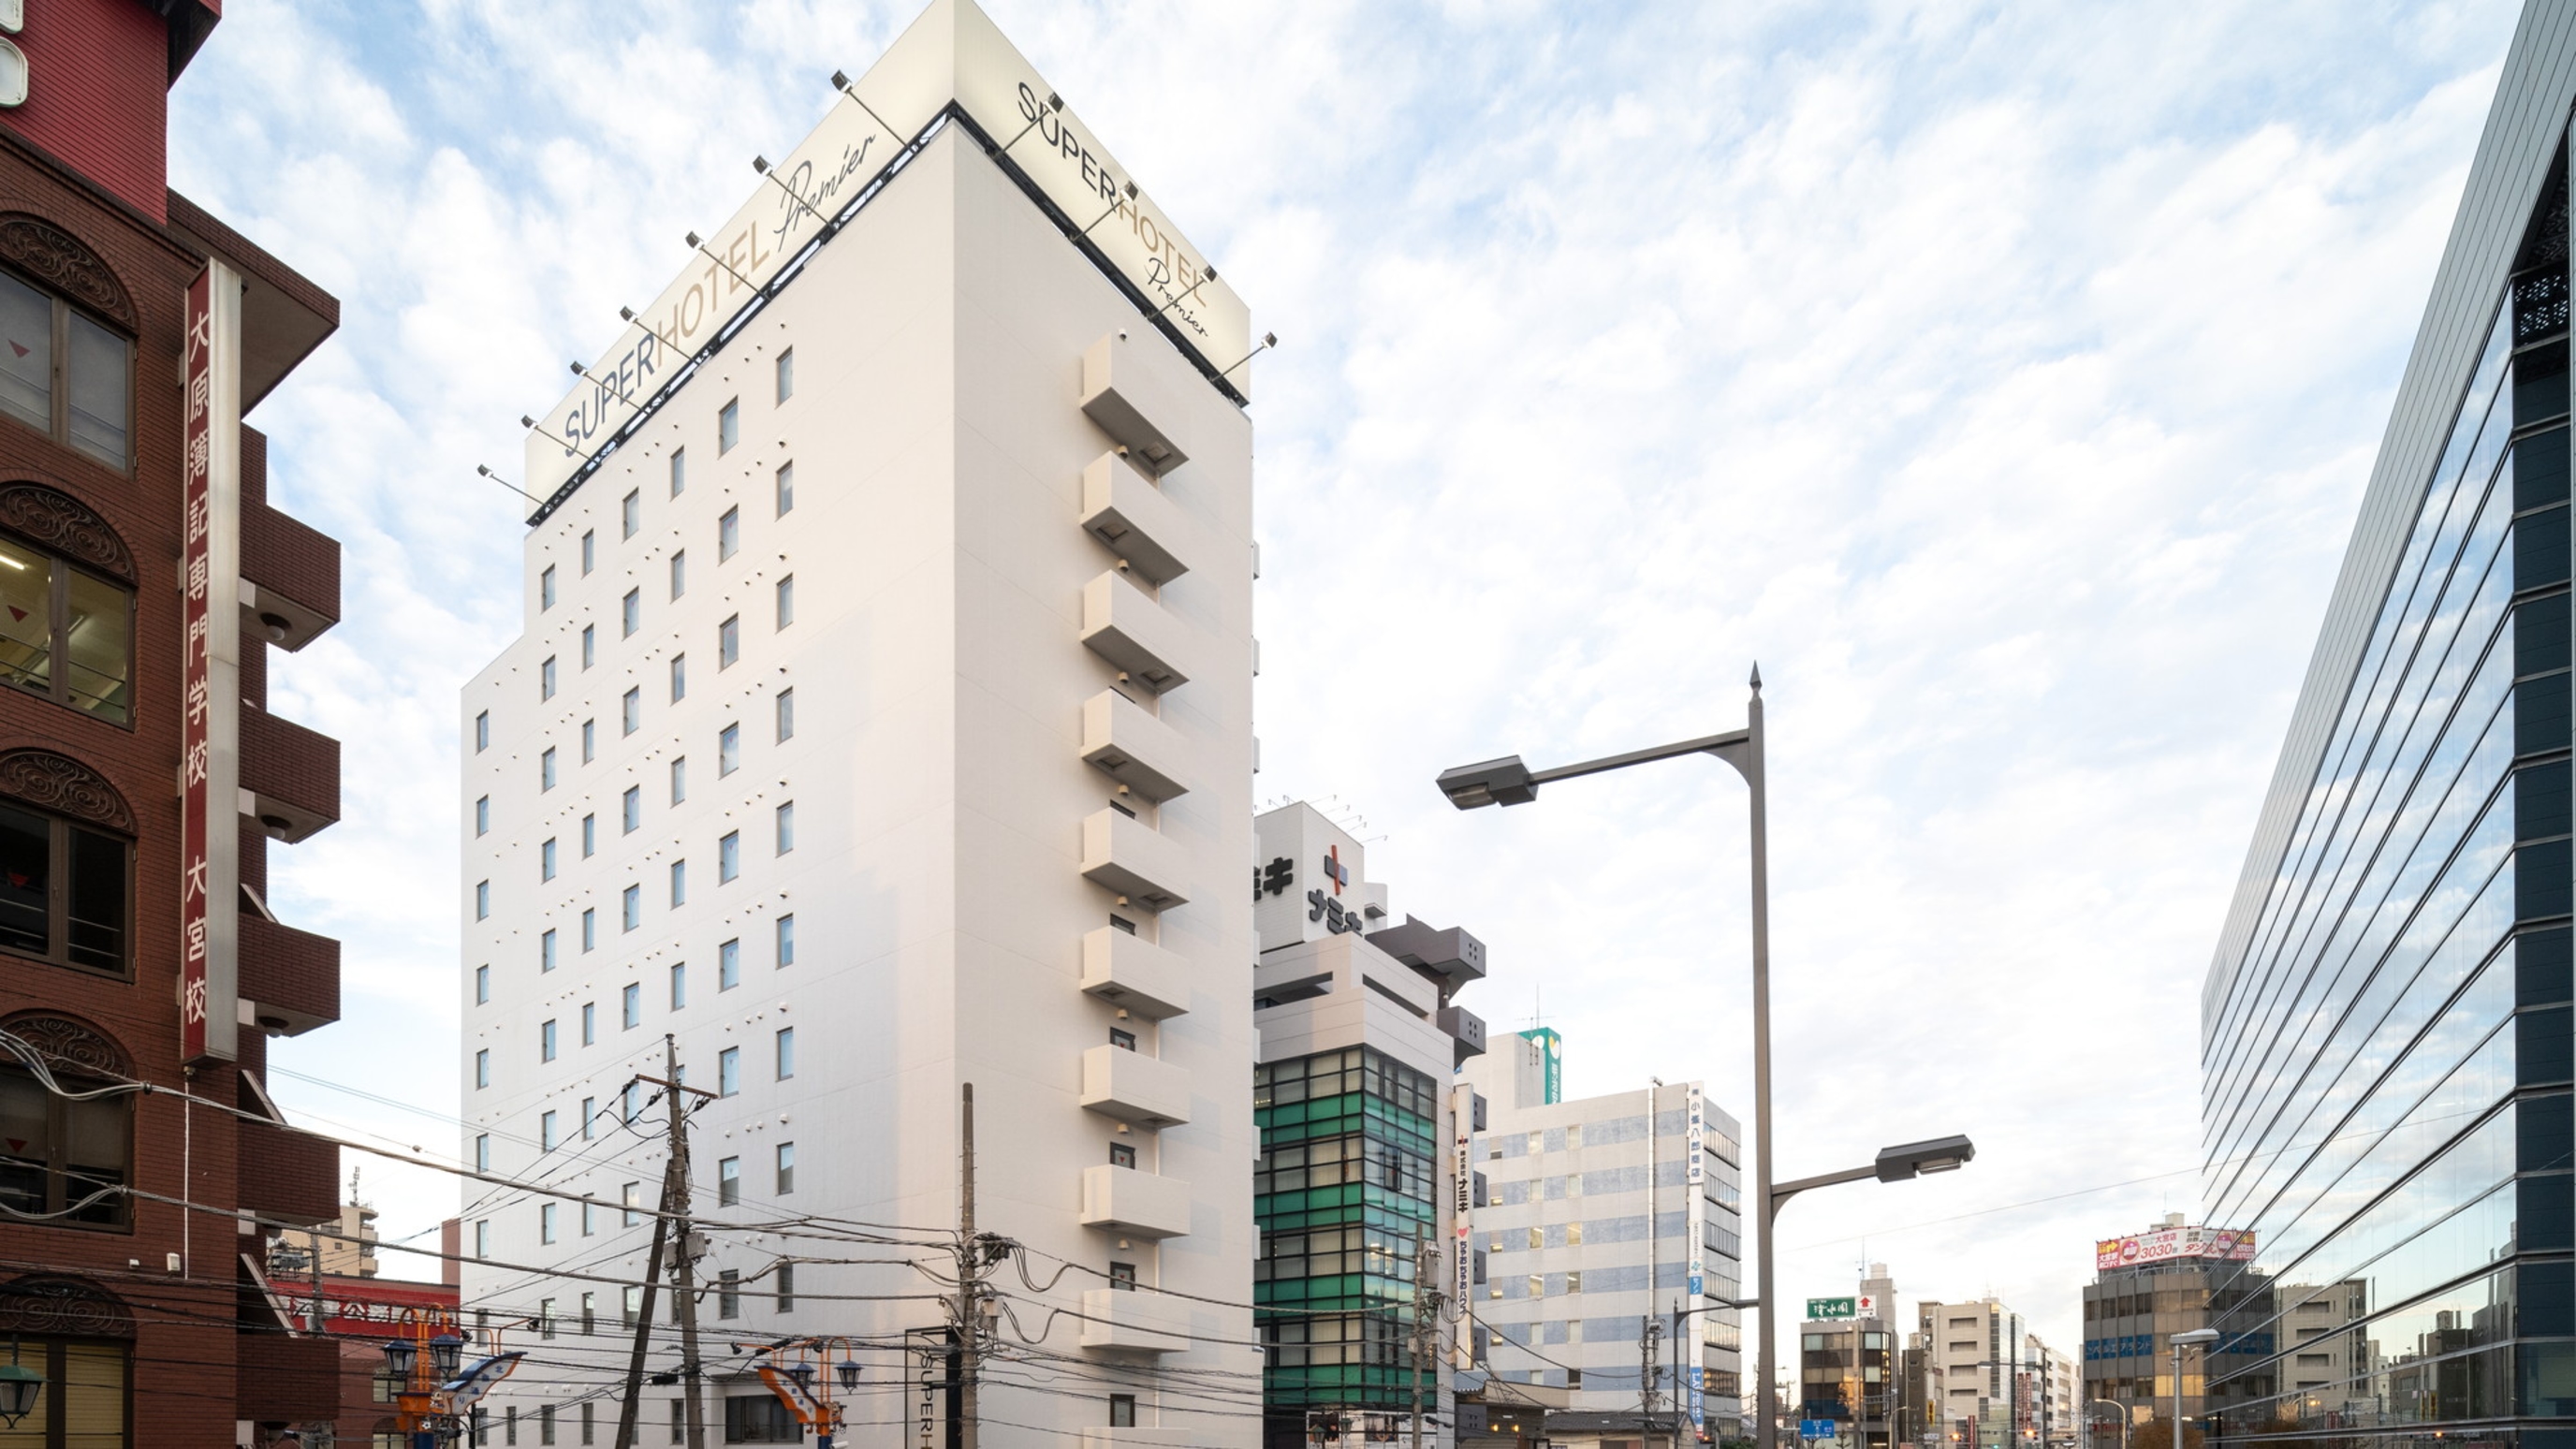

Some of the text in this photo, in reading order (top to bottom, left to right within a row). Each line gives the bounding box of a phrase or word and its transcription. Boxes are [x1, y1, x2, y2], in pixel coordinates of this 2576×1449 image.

[774, 133, 876, 252] Premier
[1145, 256, 1208, 337] Premier
[186, 310, 210, 1024] 大原簿記専門学校 大宮校
